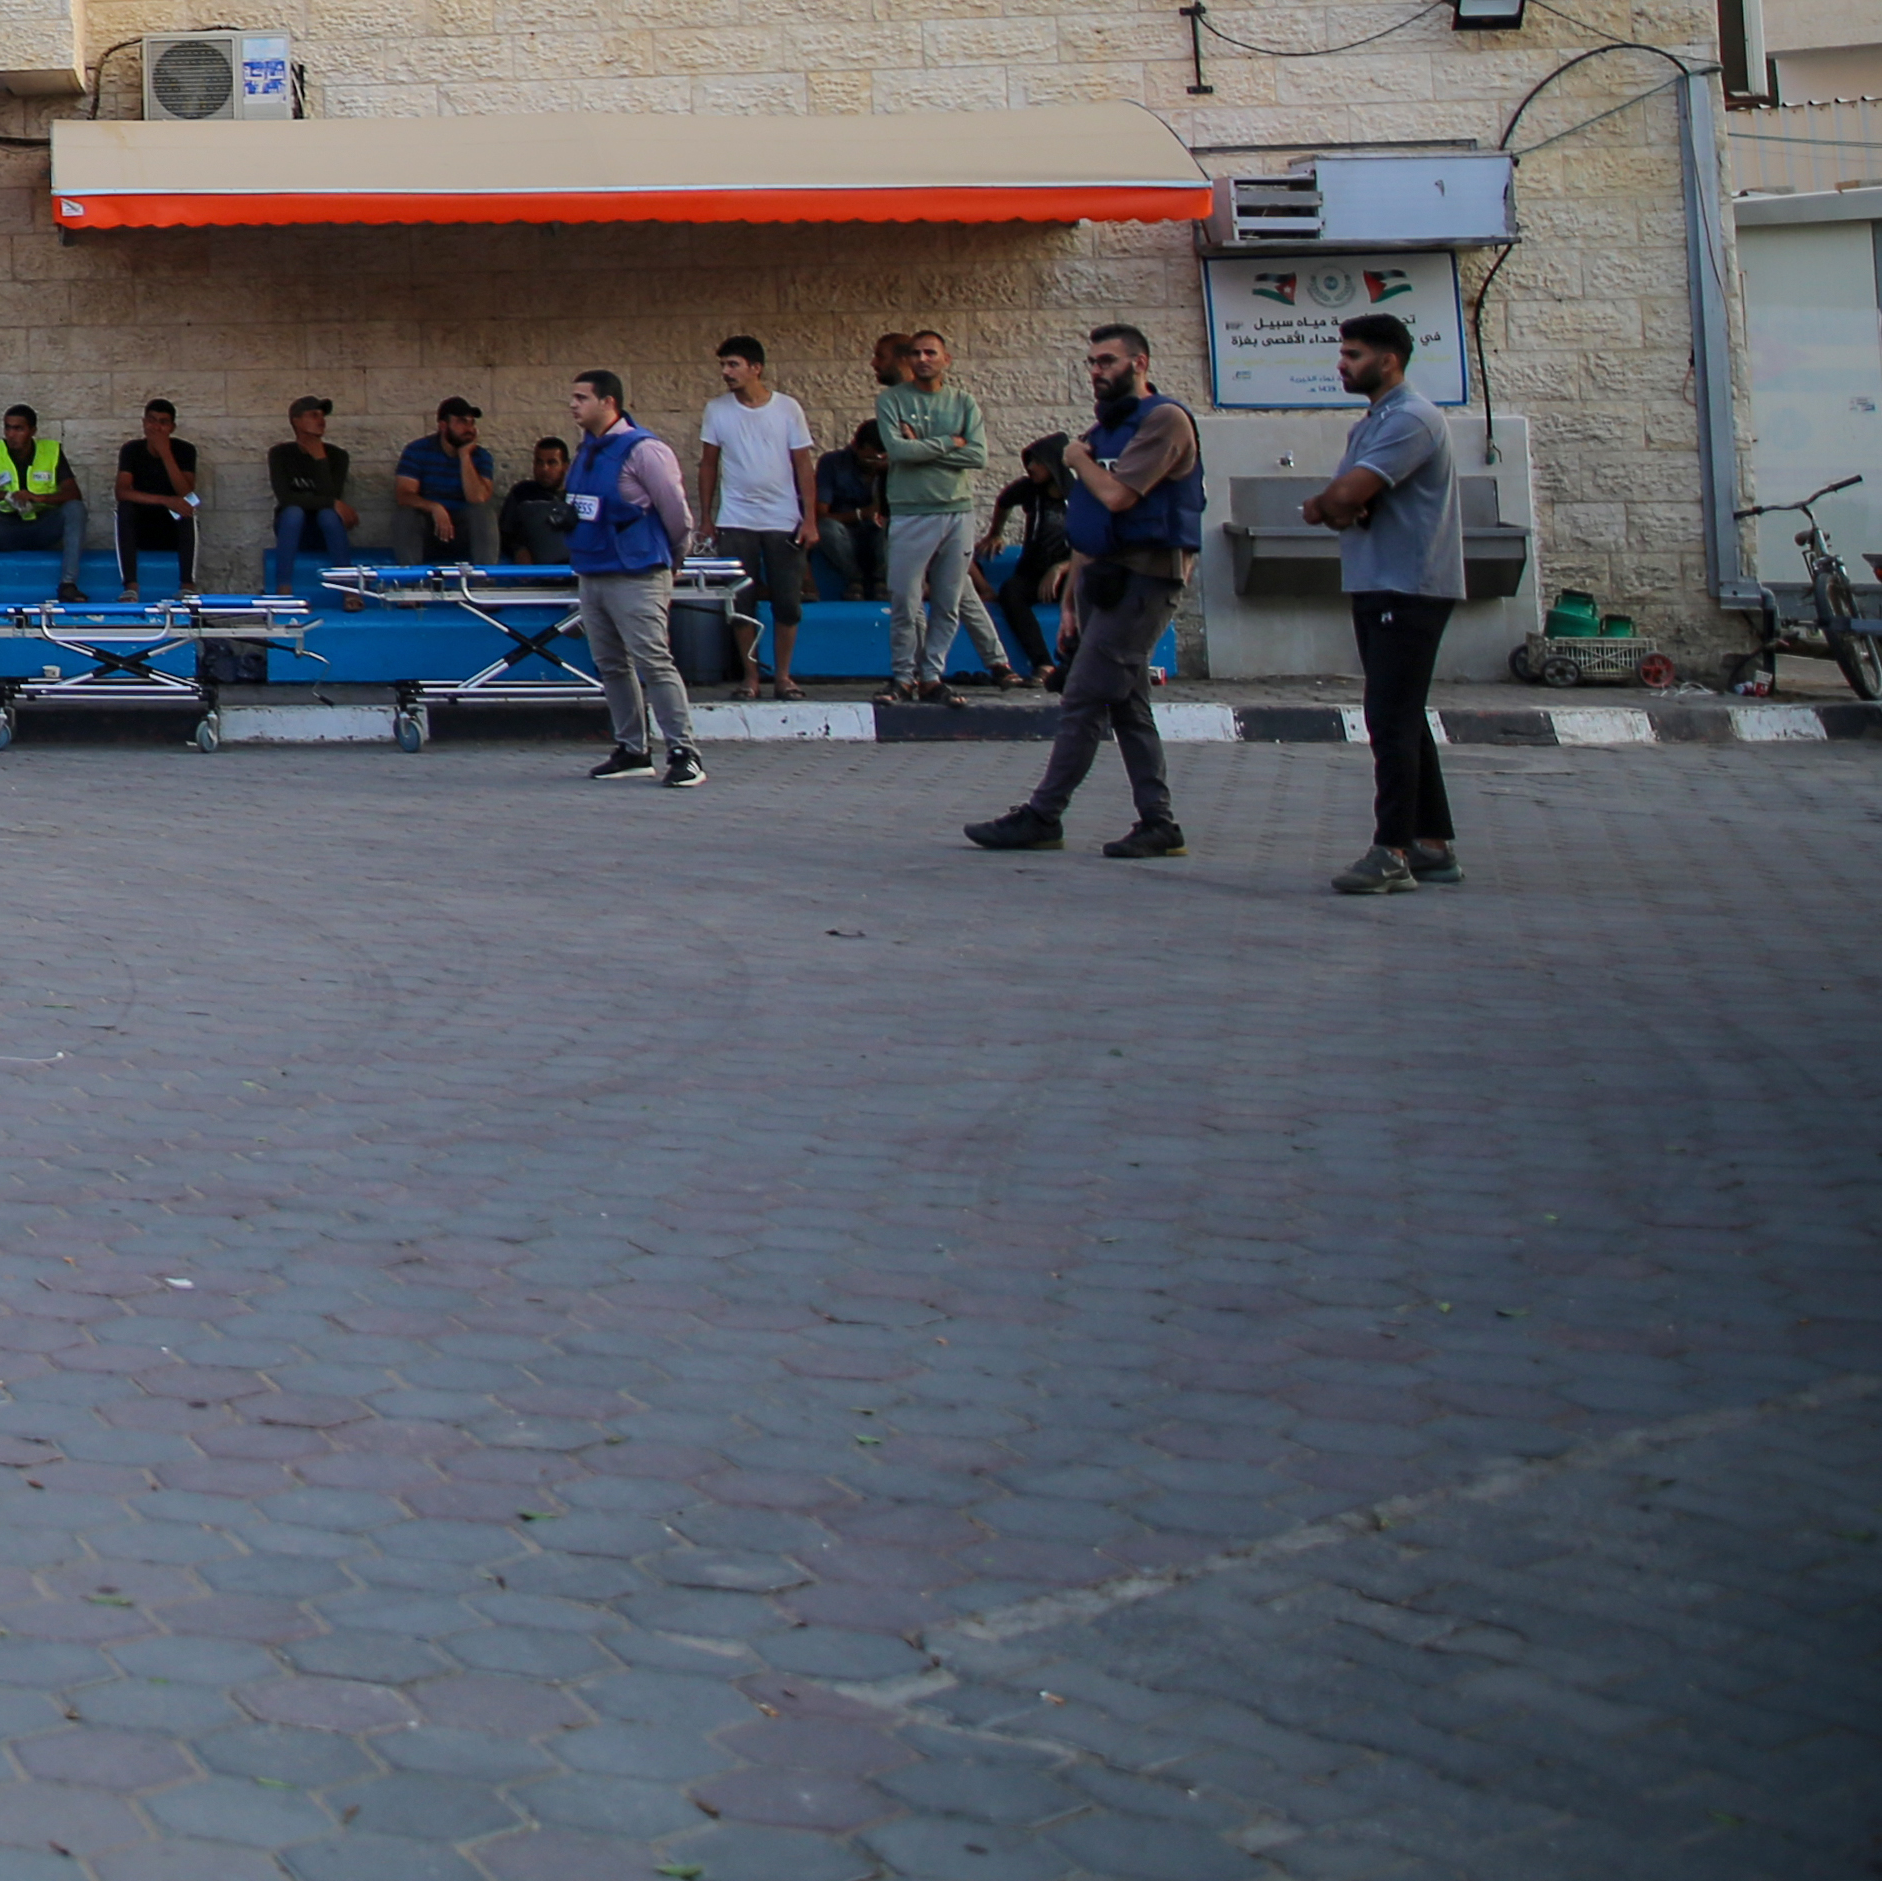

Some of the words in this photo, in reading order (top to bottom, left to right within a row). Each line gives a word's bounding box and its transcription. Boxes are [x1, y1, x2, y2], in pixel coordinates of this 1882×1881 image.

[1231, 335, 1258, 349] بغزة
[1262, 330, 1305, 347] الأقصى
[1420, 331, 1441, 347] في
